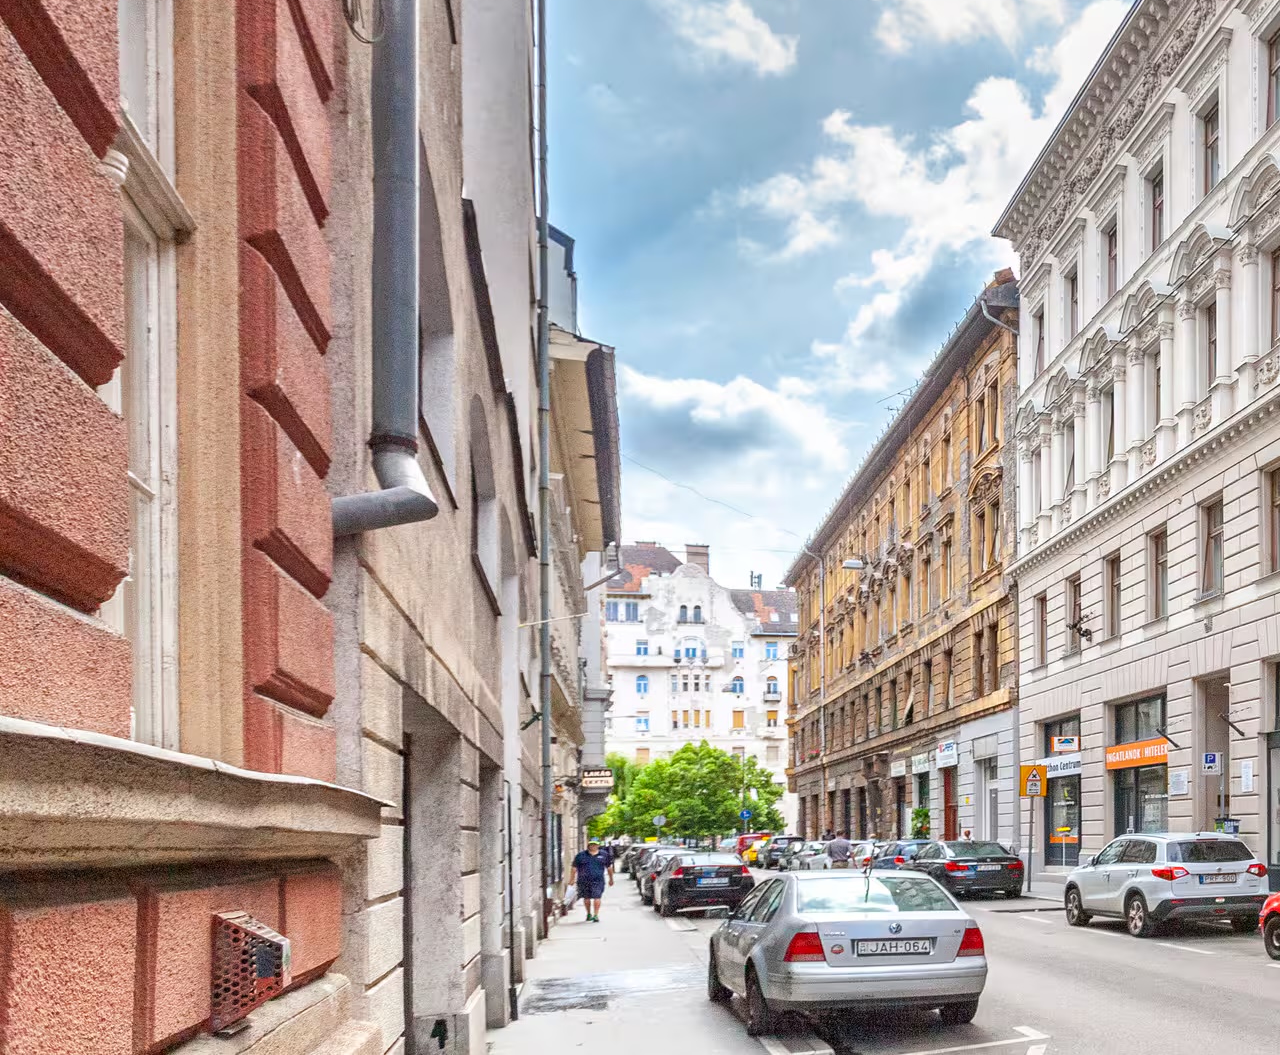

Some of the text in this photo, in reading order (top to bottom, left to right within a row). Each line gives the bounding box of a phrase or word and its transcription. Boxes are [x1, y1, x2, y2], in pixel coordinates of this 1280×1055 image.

[1106, 744, 1168, 763] INGATLANOK HITELEK
[869, 942, 928, 953] JAH-064
